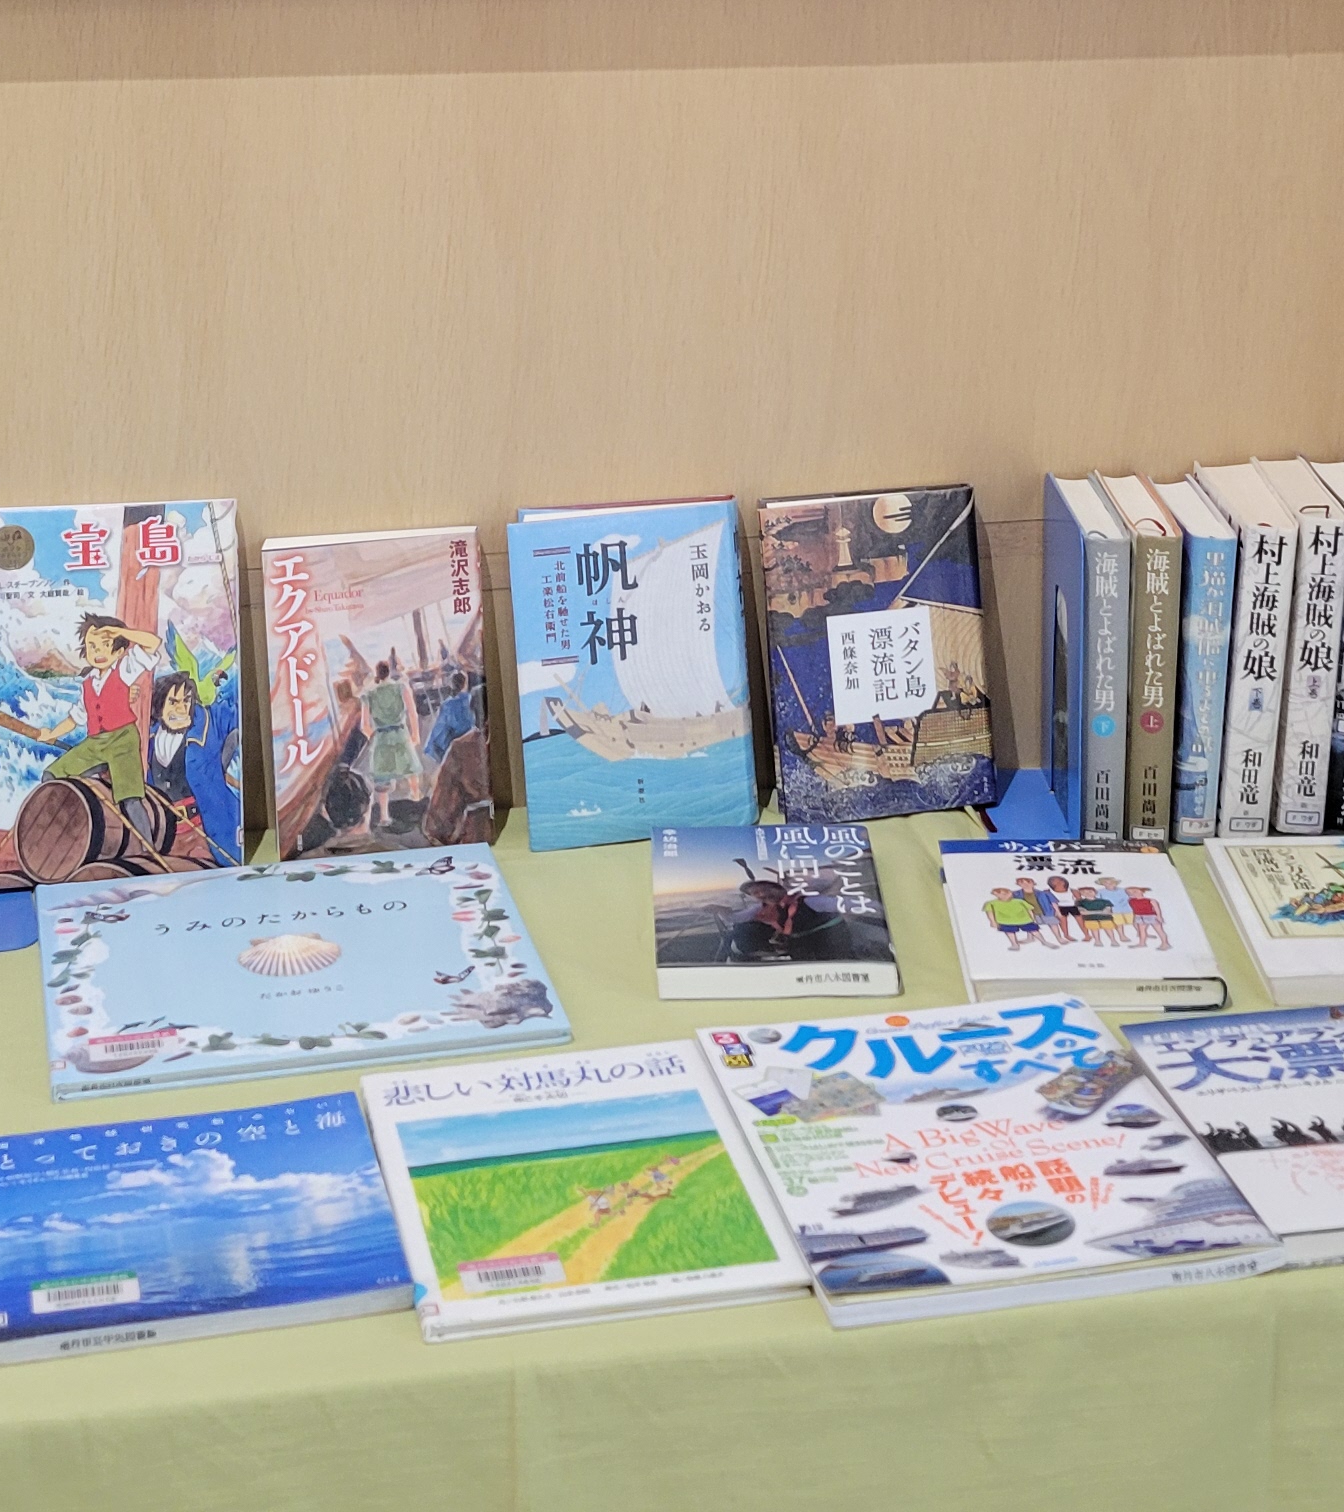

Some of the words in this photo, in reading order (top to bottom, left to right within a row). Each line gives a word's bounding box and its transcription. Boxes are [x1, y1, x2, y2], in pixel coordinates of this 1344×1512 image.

[61, 515, 183, 574] 宝島
[448, 540, 472, 615] 滝沢志郎
[313, 587, 364, 603] Equador
[554, 560, 571, 651] 北前船を馳せた男
[575, 539, 640, 666] 帆神
[689, 543, 712, 632] 玉岡かおる
[1240, 533, 1289, 683] 村上海賊の娘
[1297, 525, 1344, 674] 村上海賊の娘
[900, 622, 927, 699] バタン島
[1093, 551, 1120, 712] 海賊とよばれた男
[1141, 548, 1170, 708] 海賊とよばれた男
[270, 555, 325, 775] エクアドール
[868, 625, 899, 703] 漂流記
[1238, 748, 1262, 805] 和田竜
[1295, 740, 1320, 798] 和田竜
[819, 826, 878, 915] 風のことは
[999, 841, 1107, 853] サバイバー
[1013, 854, 1103, 875] 漂流
[153, 899, 409, 936] うみのたからもの
[779, 992, 1101, 1080] クルーズ
[383, 1051, 688, 1108] 悲しい対馬丸の話
[854, 1161, 920, 1179] New
[925, 1146, 1024, 1171] Cruise
[1025, 1133, 1126, 1156] Scene!
[883, 1133, 913, 1153] A
[917, 1127, 982, 1149] Big
[974, 1117, 1068, 1139] Wave
[962, 1169, 1006, 1201] 続々
[999, 1162, 1037, 1192] 船が
[1035, 1157, 1087, 1204] 話題の
